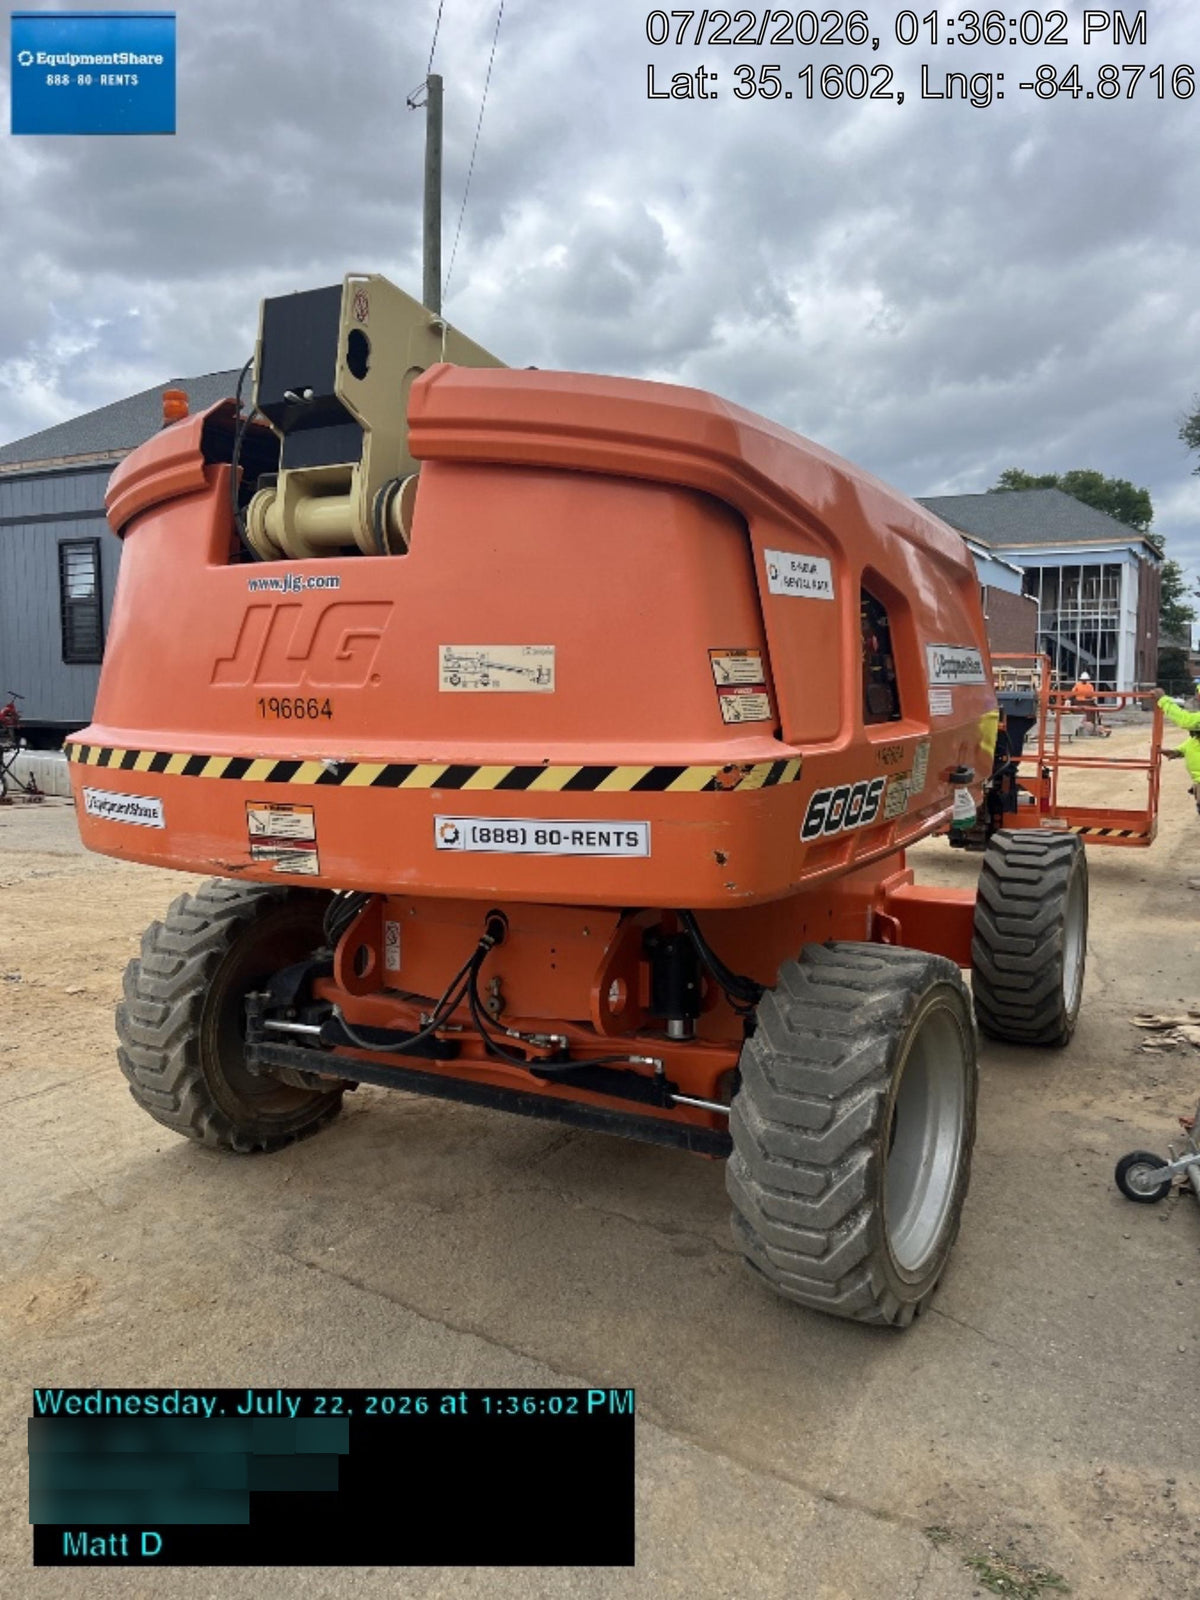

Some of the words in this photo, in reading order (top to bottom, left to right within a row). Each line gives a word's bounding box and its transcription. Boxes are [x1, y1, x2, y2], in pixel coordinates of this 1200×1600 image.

[248, 574, 340, 592] www.jlg.com
[257, 698, 334, 720] 196664
[471, 826, 527, 845] (888)
[534, 829, 639, 847] 80-RENTS
